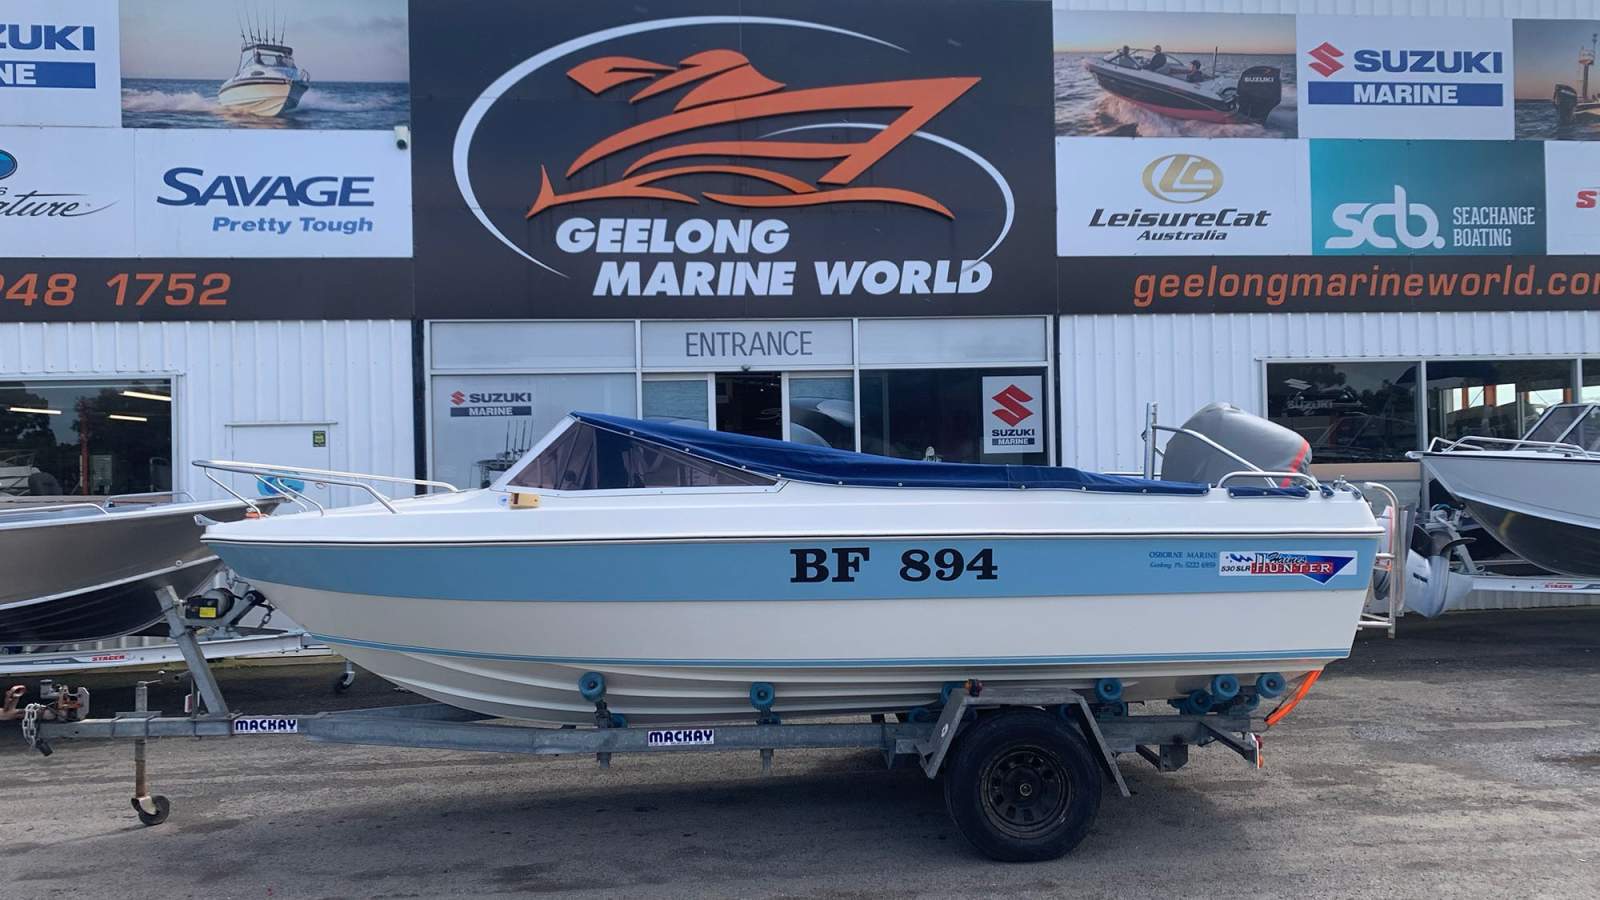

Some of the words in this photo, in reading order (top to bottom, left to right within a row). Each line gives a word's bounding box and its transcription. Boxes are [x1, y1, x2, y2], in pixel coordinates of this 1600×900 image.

[0, 24, 95, 51] UKI
[1354, 50, 1503, 73] SUZUKI
[1353, 83, 1459, 104] MARINE
[156, 167, 375, 207] SAVAGE
[1088, 208, 1272, 227] LeisureCat
[1452, 206, 1536, 226] SEACHANGE
[212, 217, 292, 235] Pretty
[299, 217, 373, 235] Tough
[555, 217, 790, 254] GEELONG
[1136, 230, 1228, 241] Australia
[1452, 228, 1512, 247] BOATING
[592, 261, 797, 296] MARINE
[814, 260, 993, 295] WORLD
[0, 272, 78, 307] 48
[106, 271, 232, 307] 1752
[685, 331, 813, 357] ENTRANCE
[469, 393, 532, 403] SUZUKI
[468, 407, 513, 416] MARINE
[992, 429, 1035, 437] SUZUKI
[1148, 551, 1183, 559] OSBORNE
[1187, 551, 1217, 559] MARINE
[1253, 552, 1331, 573] HUNTER
[1266, 552, 1306, 564] Haines
[790, 547, 870, 583] BF
[899, 548, 998, 582] 894
[1221, 565, 1235, 573] 530
[235, 719, 296, 730] MACKAY
[649, 730, 713, 743] MACKAY
